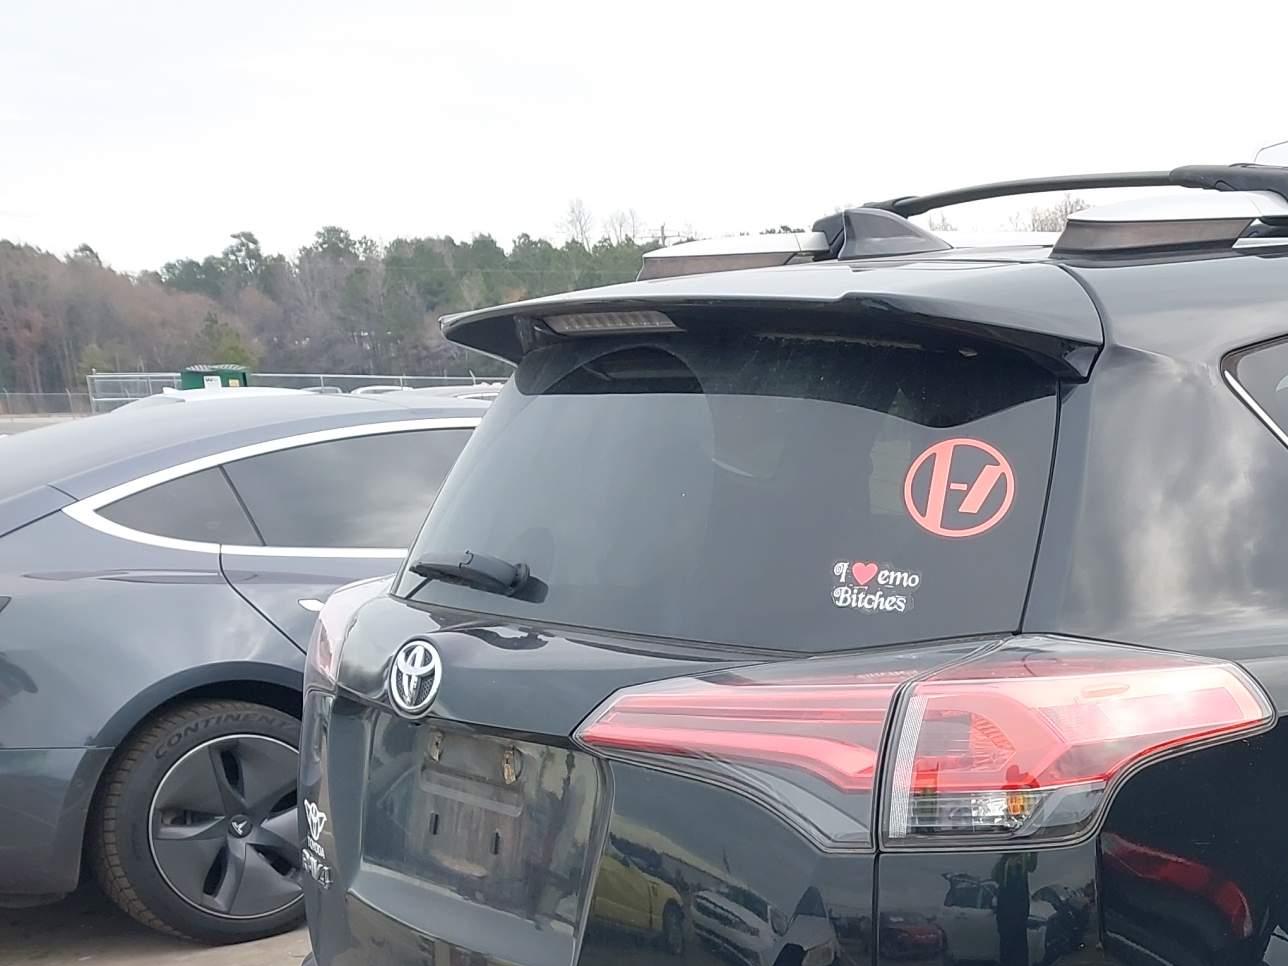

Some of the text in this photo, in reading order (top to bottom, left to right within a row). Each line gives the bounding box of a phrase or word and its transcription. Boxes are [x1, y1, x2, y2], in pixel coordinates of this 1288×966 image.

[833, 562, 920, 588] I emo
[833, 586, 906, 612] Bitches
